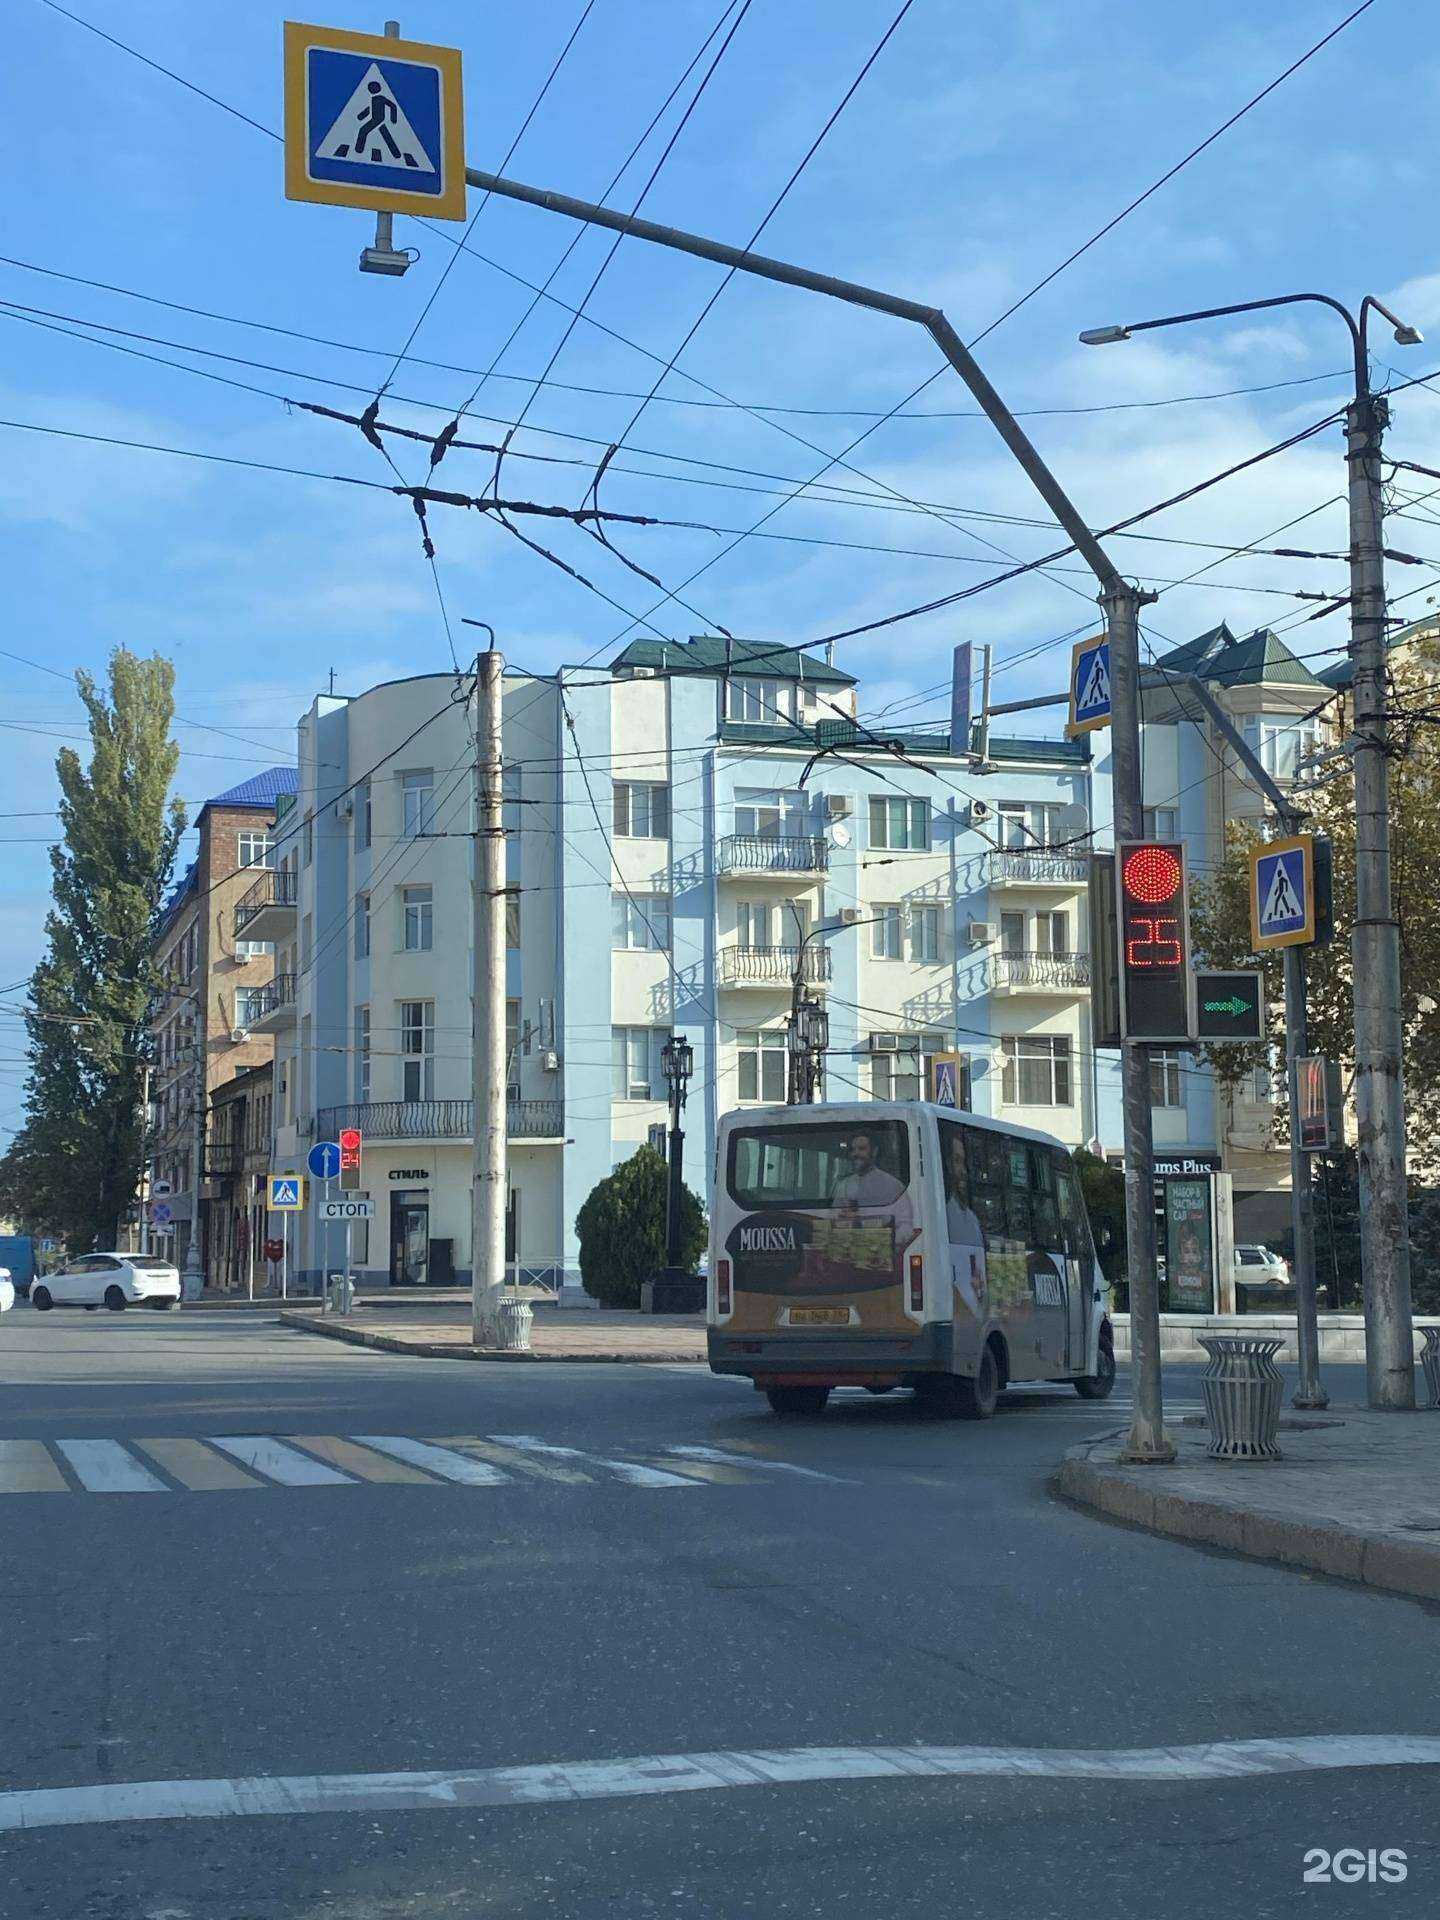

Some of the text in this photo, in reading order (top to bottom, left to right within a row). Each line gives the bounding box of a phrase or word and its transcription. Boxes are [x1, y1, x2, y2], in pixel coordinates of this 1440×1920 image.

[1128, 918, 1181, 966] 25
[341, 1152, 359, 1169] 24
[1183, 1160, 1212, 1174] Plus
[326, 1203, 367, 1217] СТОП
[740, 1226, 796, 1251] MOUSSA
